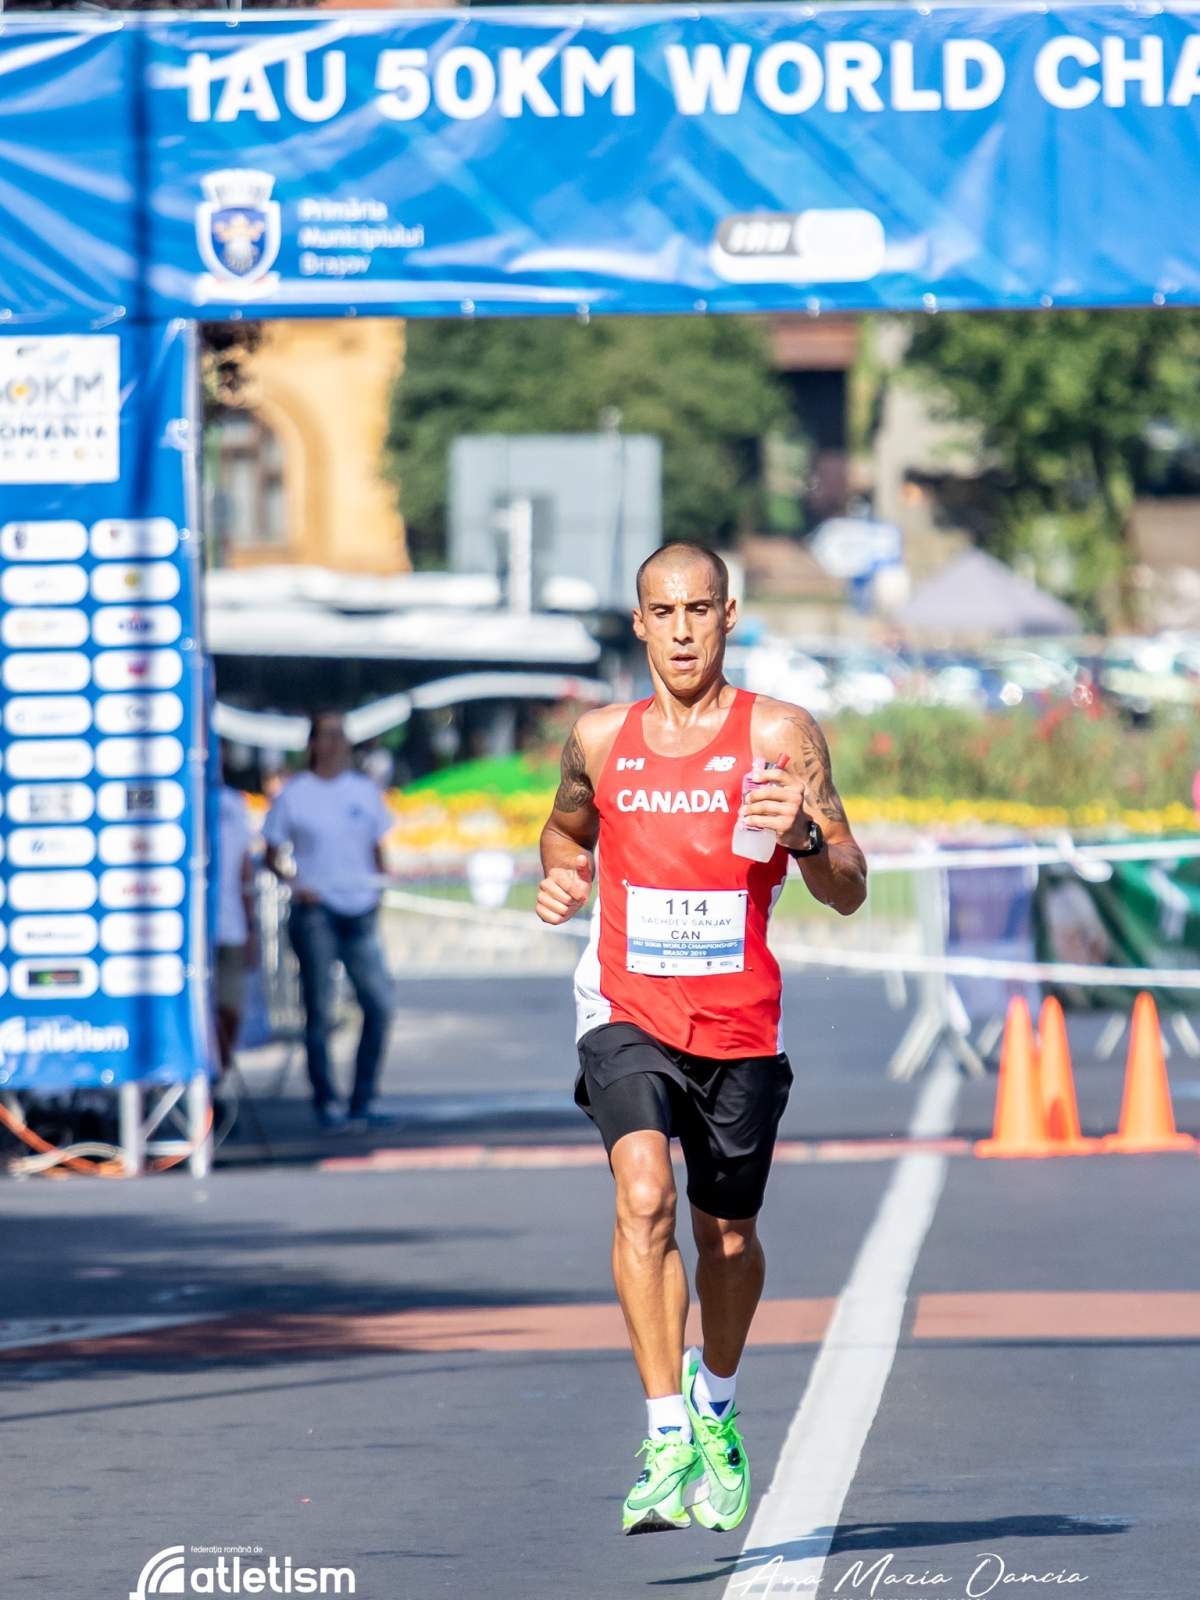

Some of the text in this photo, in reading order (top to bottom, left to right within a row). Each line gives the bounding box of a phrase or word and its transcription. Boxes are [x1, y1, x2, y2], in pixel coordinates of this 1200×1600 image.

[373, 45, 637, 121] 50KM
[664, 38, 1006, 115] WORLD
[616, 788, 730, 814] CANADA
[665, 898, 708, 916] 114
[691, 918, 732, 927] SANJAY
[670, 930, 701, 940] CAN
